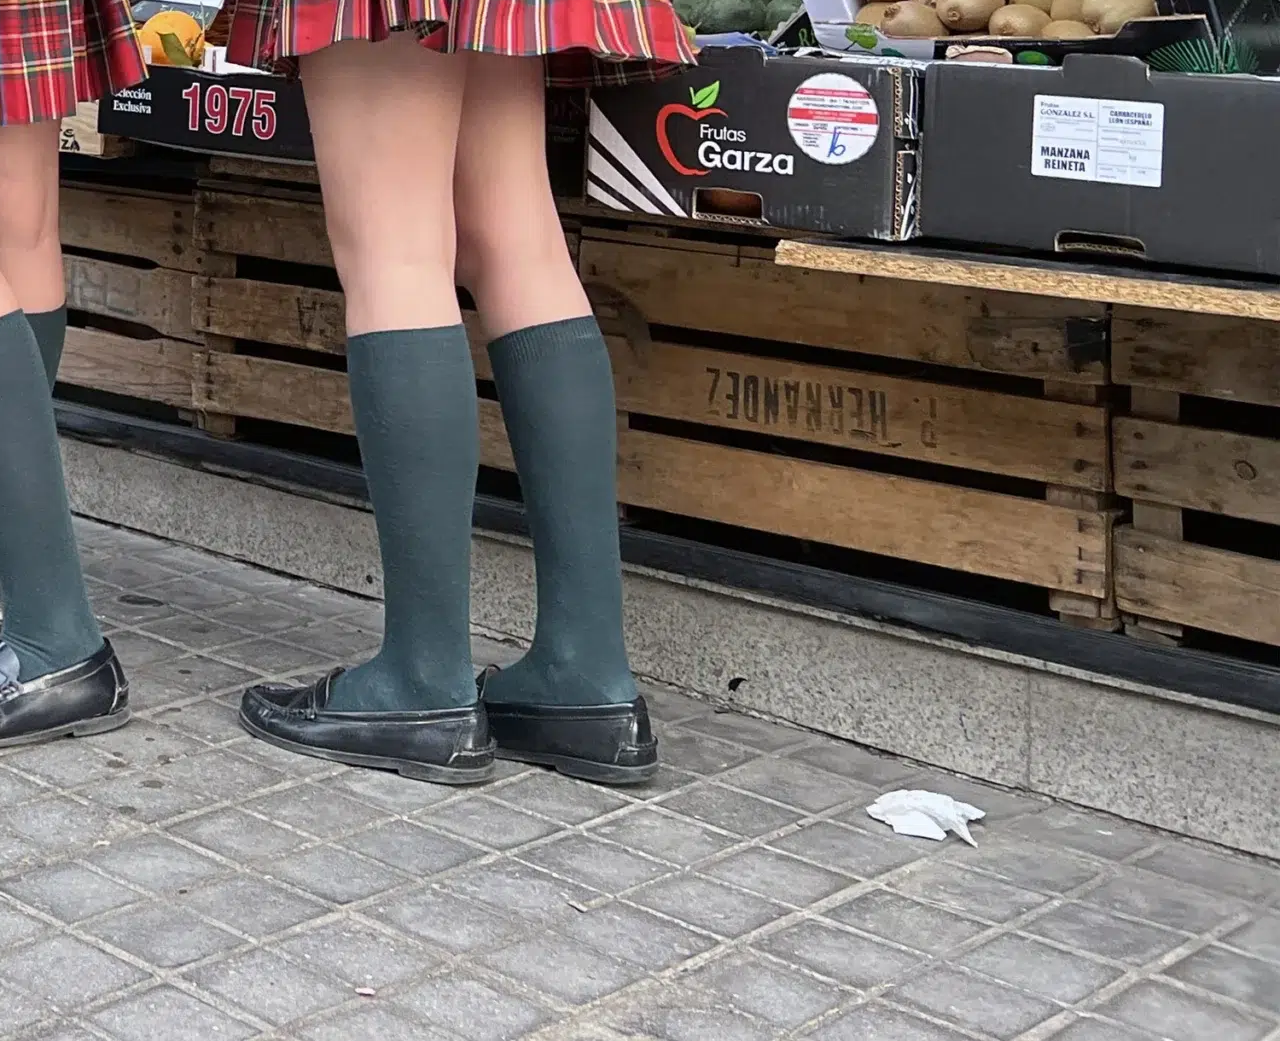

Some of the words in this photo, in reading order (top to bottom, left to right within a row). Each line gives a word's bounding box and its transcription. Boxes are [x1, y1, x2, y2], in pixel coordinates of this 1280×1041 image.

[113, 99, 152, 114] Exclusiva
[182, 82, 277, 140] 1975
[700, 123, 747, 142] Frutas
[698, 140, 794, 175] Garza
[1040, 145, 1090, 160] MANZANA
[1044, 158, 1086, 172] REINETA
[706, 367, 888, 440] HERNANDEZ
